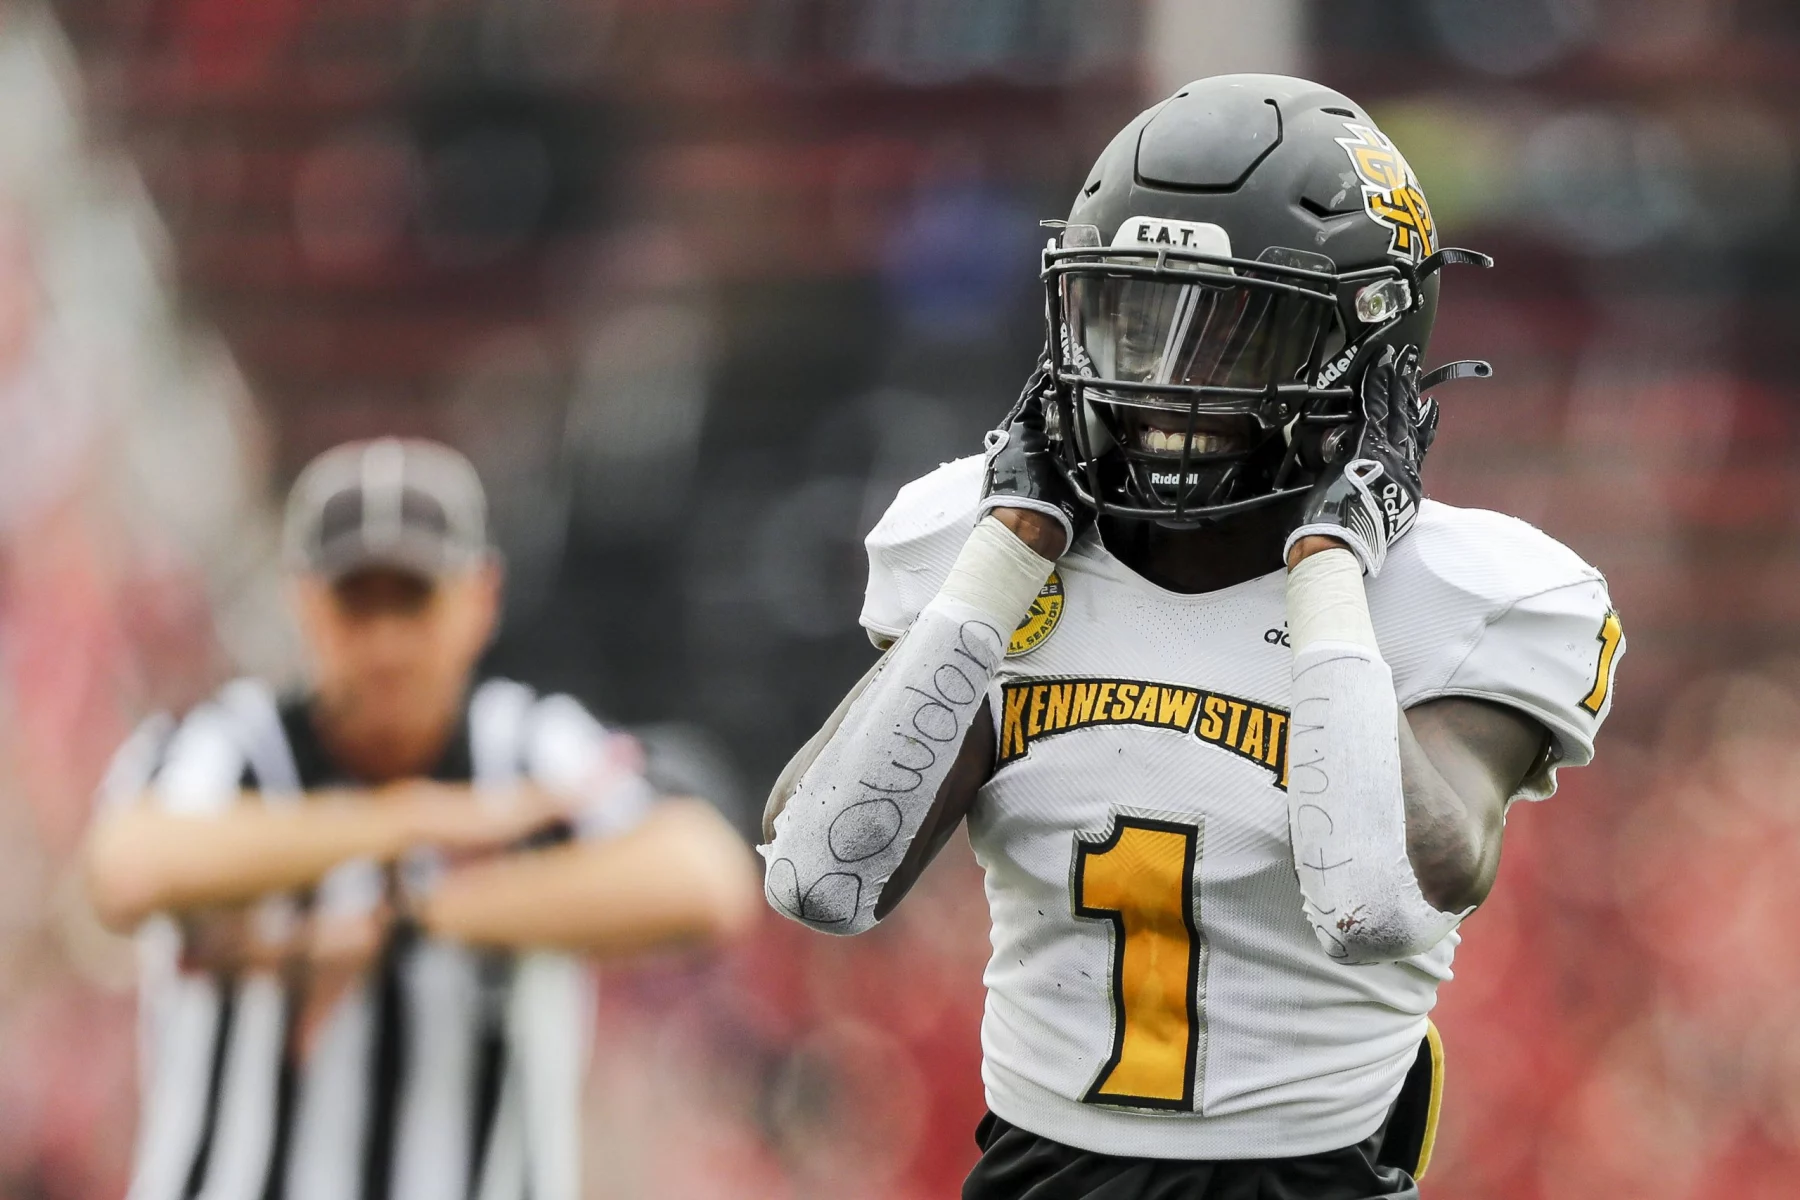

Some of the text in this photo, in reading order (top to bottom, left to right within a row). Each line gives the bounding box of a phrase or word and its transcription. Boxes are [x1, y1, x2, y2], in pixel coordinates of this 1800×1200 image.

[1137, 224, 1197, 247] E.A.T.
[1316, 344, 1358, 390] ddell
[1026, 601, 1060, 646] SEASON
[1577, 607, 1622, 718] 1
[1001, 683, 1198, 760] KENNESAW
[1073, 813, 1201, 1112] 1
